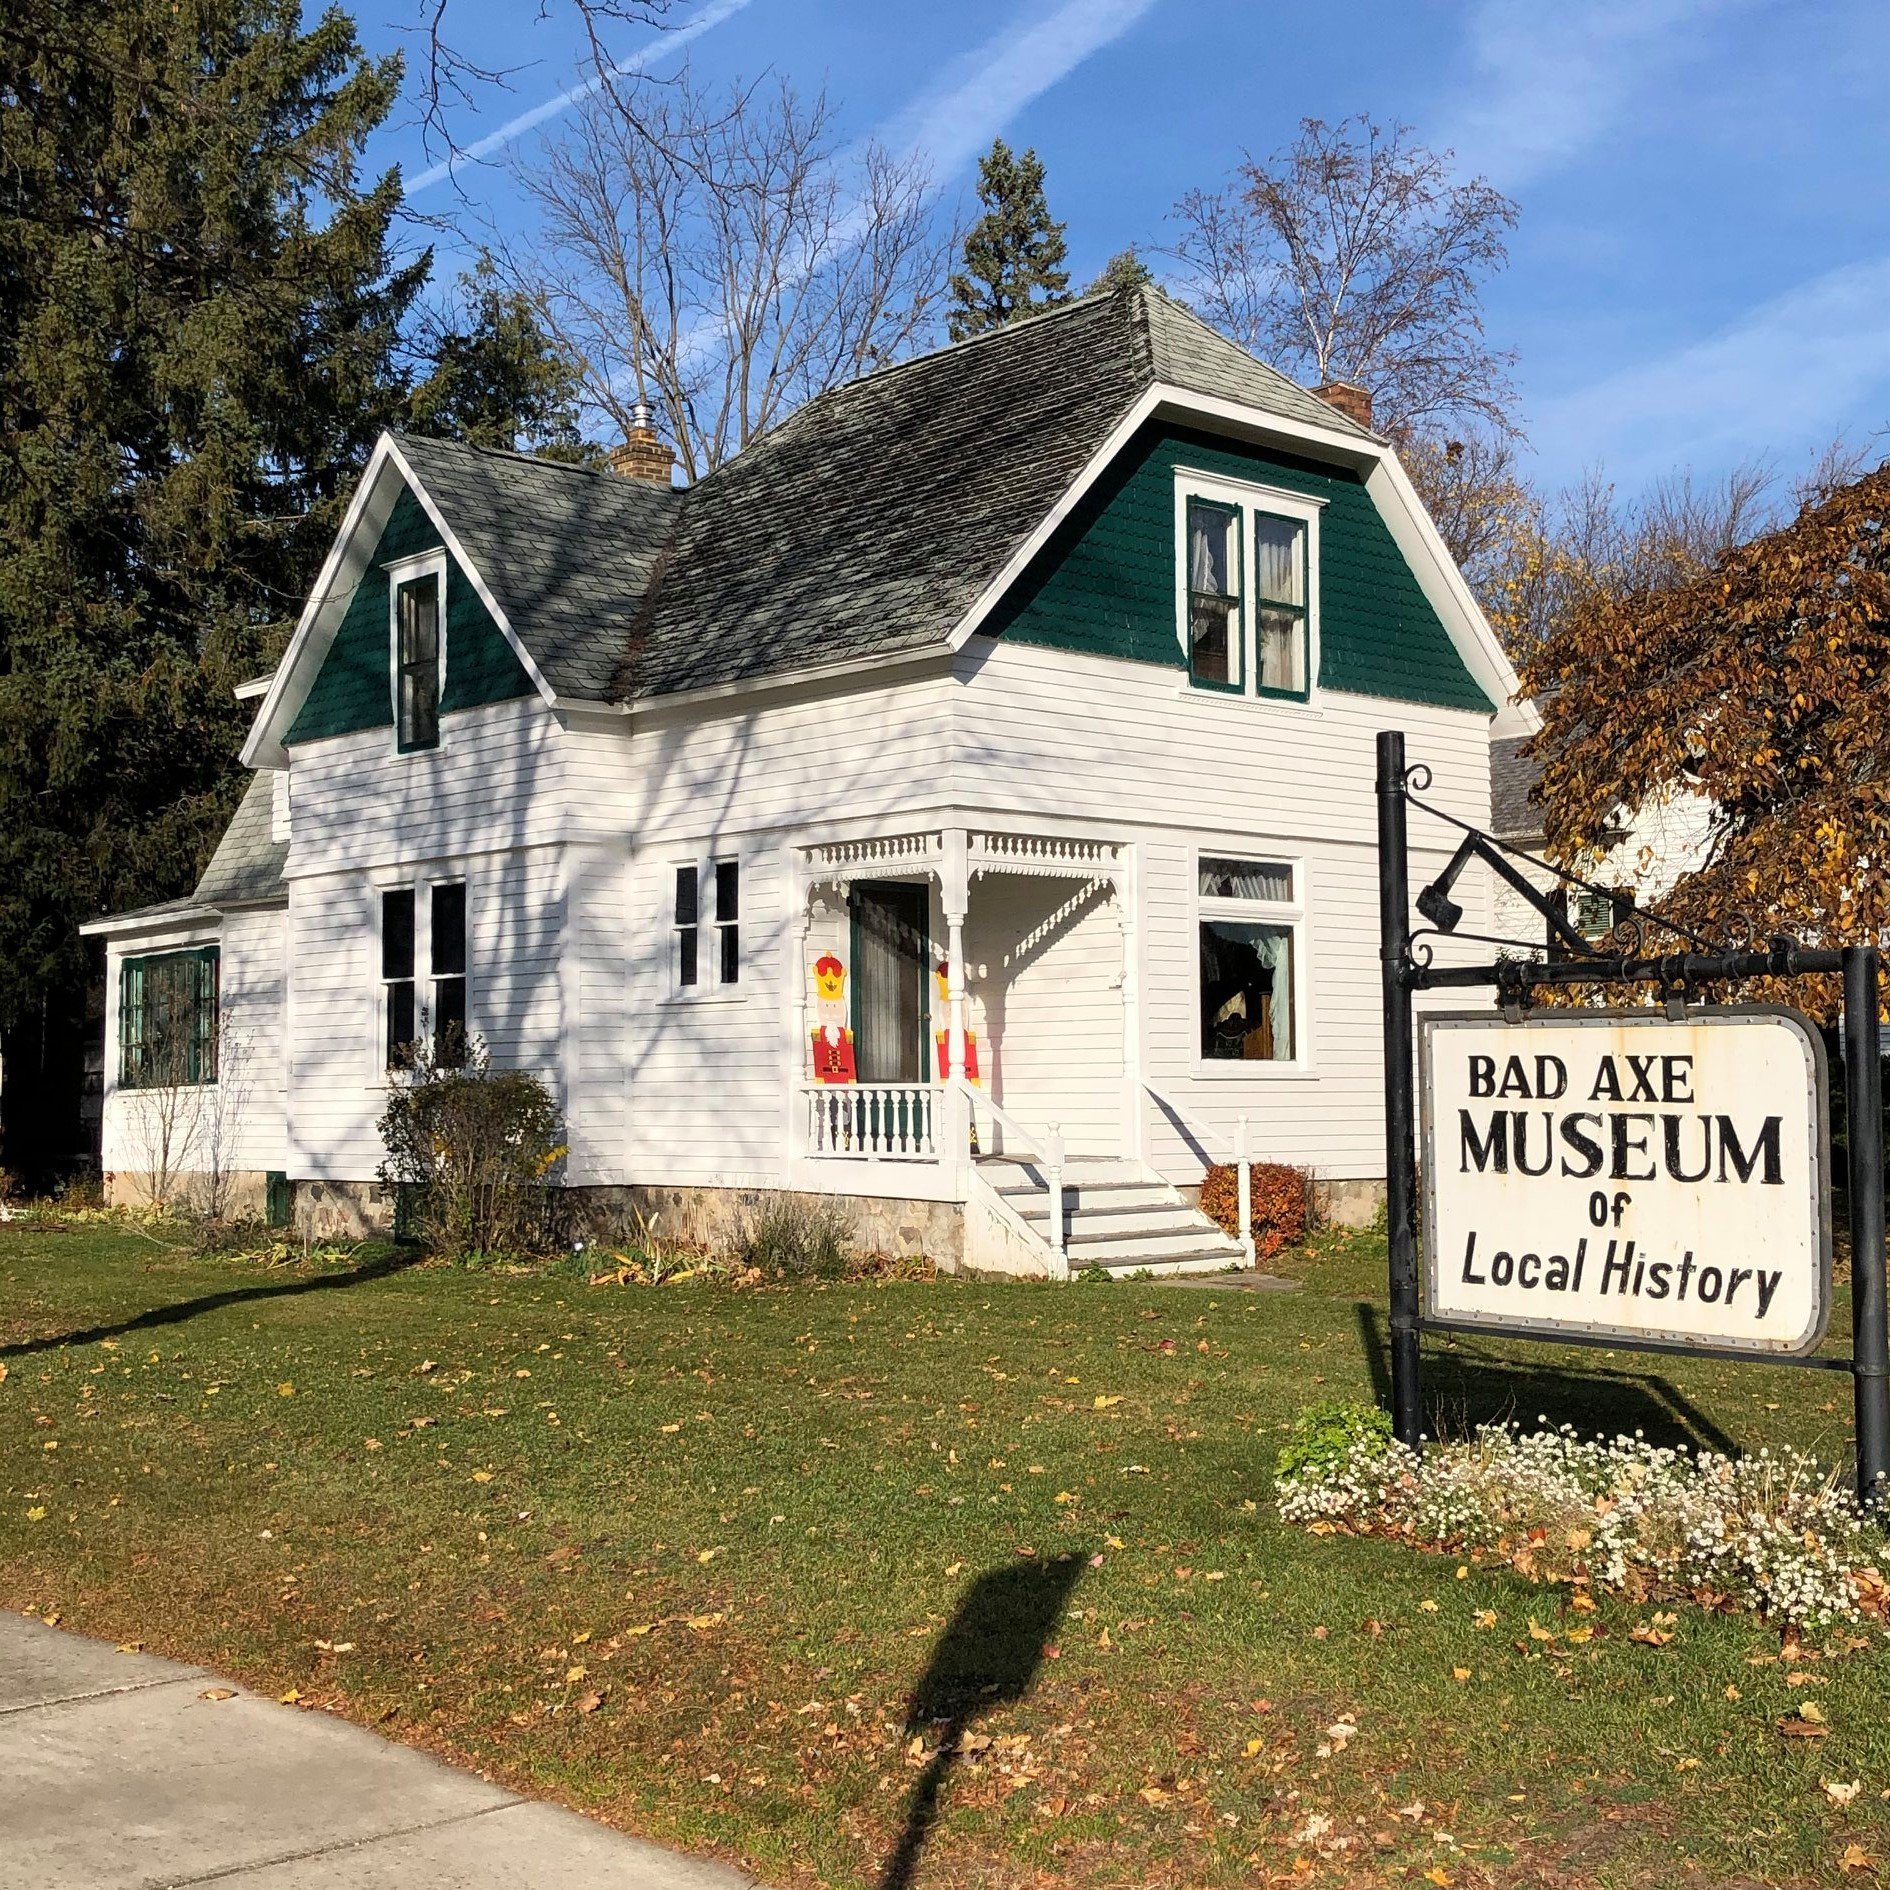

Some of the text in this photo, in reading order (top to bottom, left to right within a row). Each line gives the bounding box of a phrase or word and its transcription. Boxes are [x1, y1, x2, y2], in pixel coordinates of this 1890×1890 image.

[1467, 1055, 1695, 1104] BAD AXE
[1457, 1108, 1786, 1185] MUSEUM
[1461, 1231, 1783, 1320] Local History
